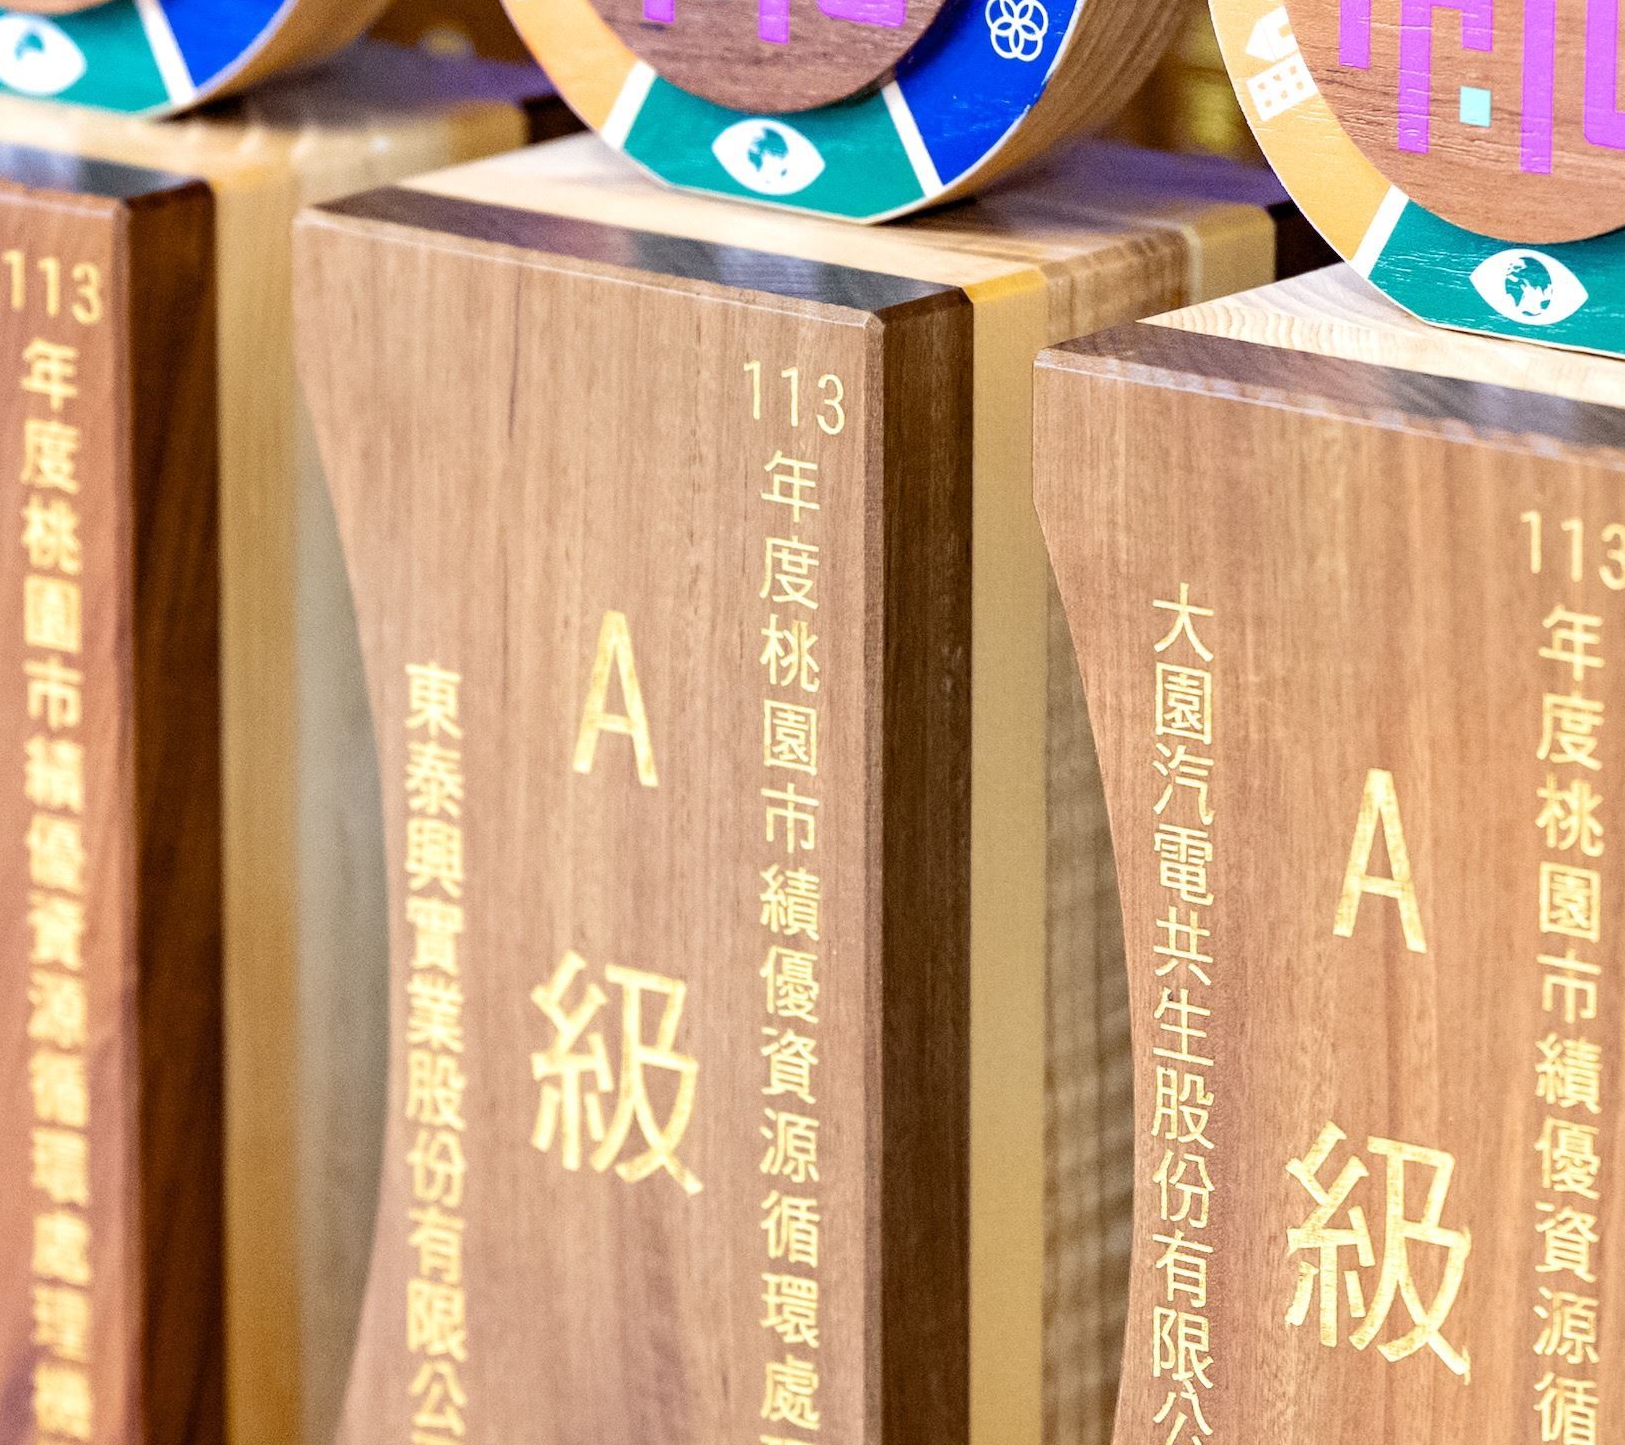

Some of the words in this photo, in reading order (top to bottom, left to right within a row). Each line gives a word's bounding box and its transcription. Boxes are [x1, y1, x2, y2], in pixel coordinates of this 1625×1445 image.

[571, 610, 658, 787] A
[1333, 769, 1428, 954] A
[530, 949, 703, 1195] 級
[1285, 1121, 1472, 1383] 級
